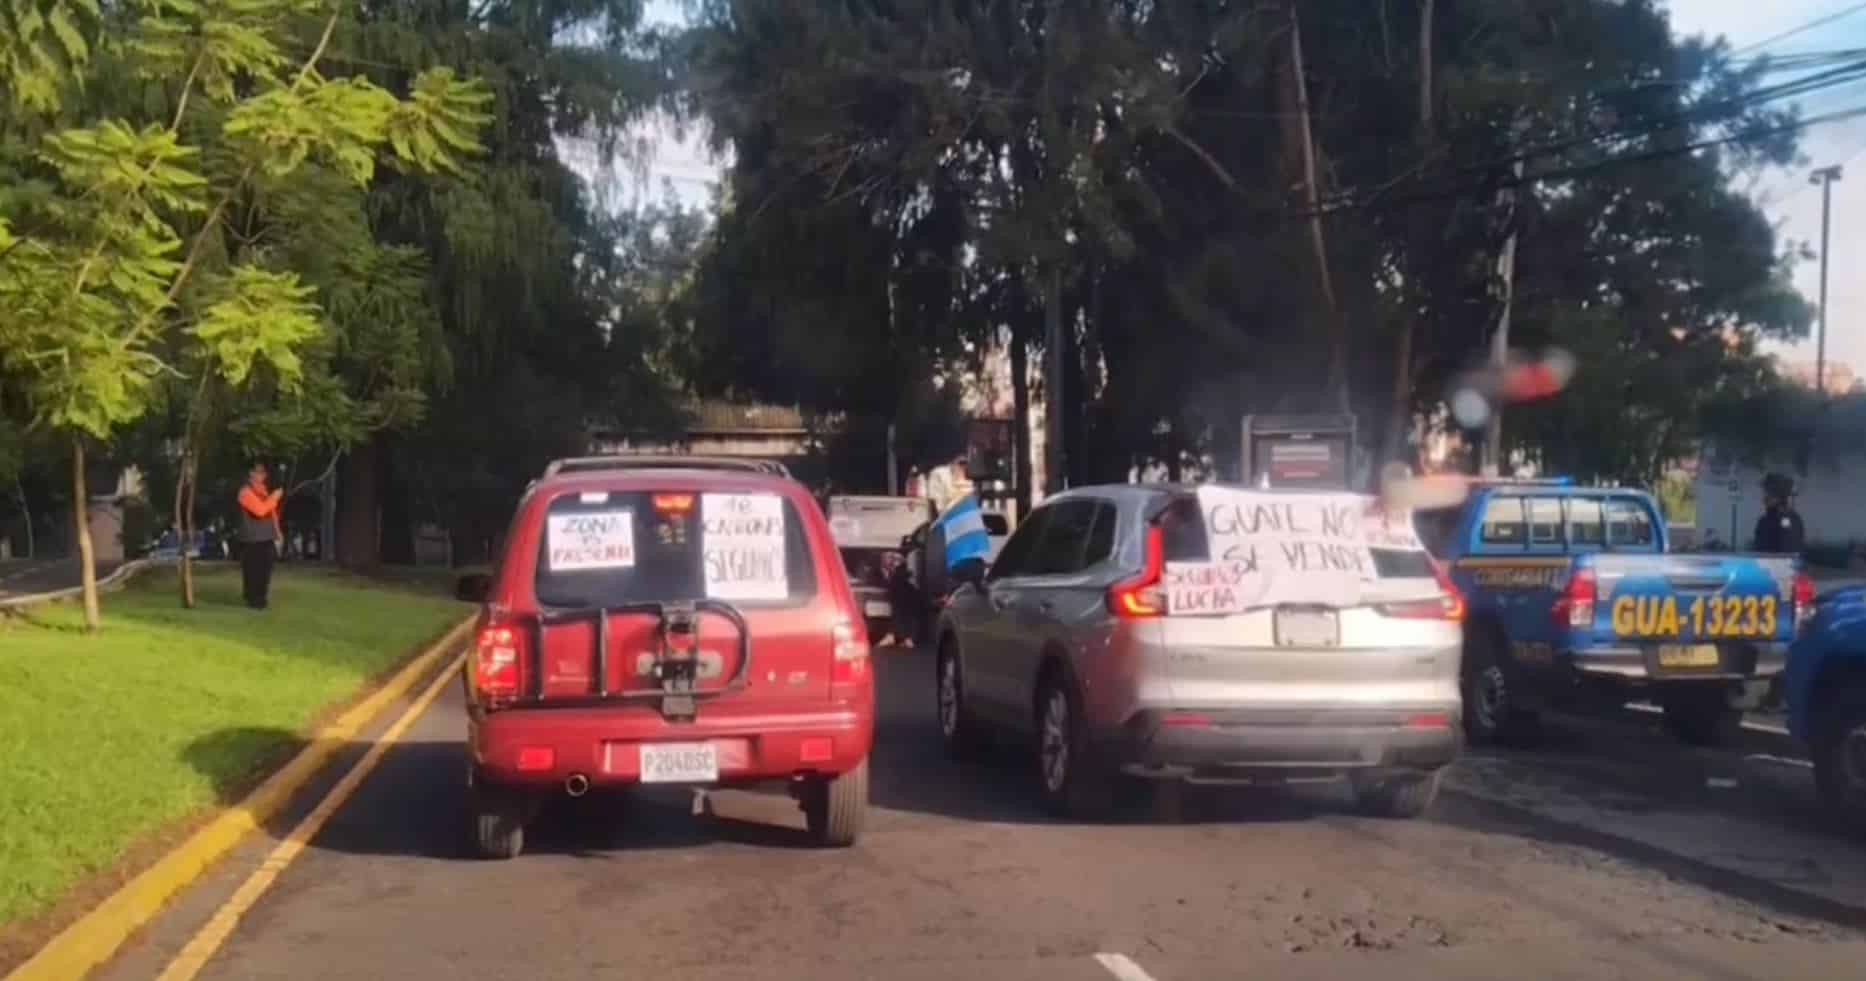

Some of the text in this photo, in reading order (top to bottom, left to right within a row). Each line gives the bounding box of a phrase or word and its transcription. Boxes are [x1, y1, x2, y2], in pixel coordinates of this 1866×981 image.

[1321, 504, 1357, 538] NO
[1174, 588, 1237, 610] LUCHA
[1612, 595, 1777, 637] GUA-13233
